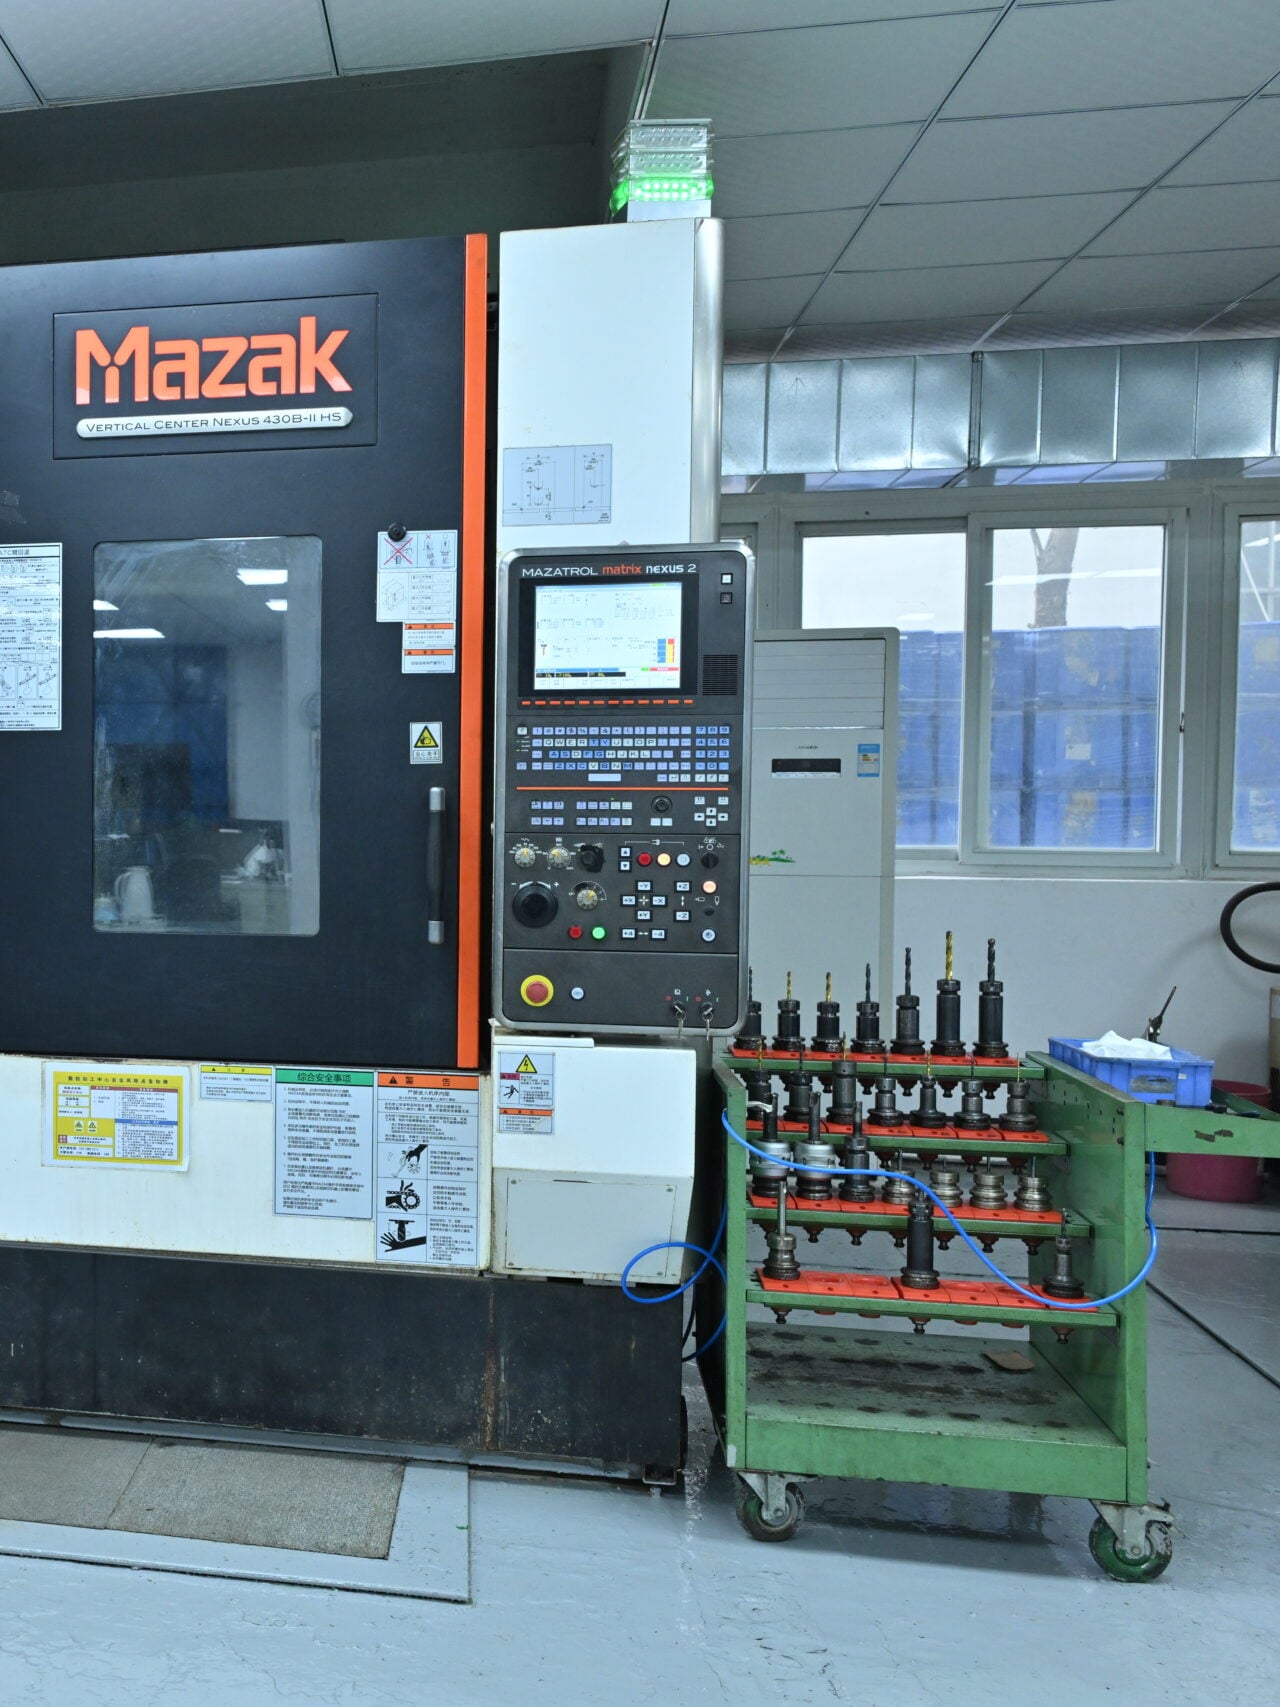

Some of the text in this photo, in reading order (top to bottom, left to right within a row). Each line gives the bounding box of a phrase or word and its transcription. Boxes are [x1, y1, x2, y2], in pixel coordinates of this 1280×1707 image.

[76, 316, 352, 405] Mazak
[86, 420, 150, 432] VERTICAL
[154, 418, 209, 430] CENTER
[213, 416, 260, 427] NEXUS
[320, 412, 342, 422] HS
[522, 566, 598, 577] MAZATROL
[602, 564, 642, 576] matrix
[687, 564, 697, 573] 2
[298, 1072, 352, 1084] 综合安全事项
